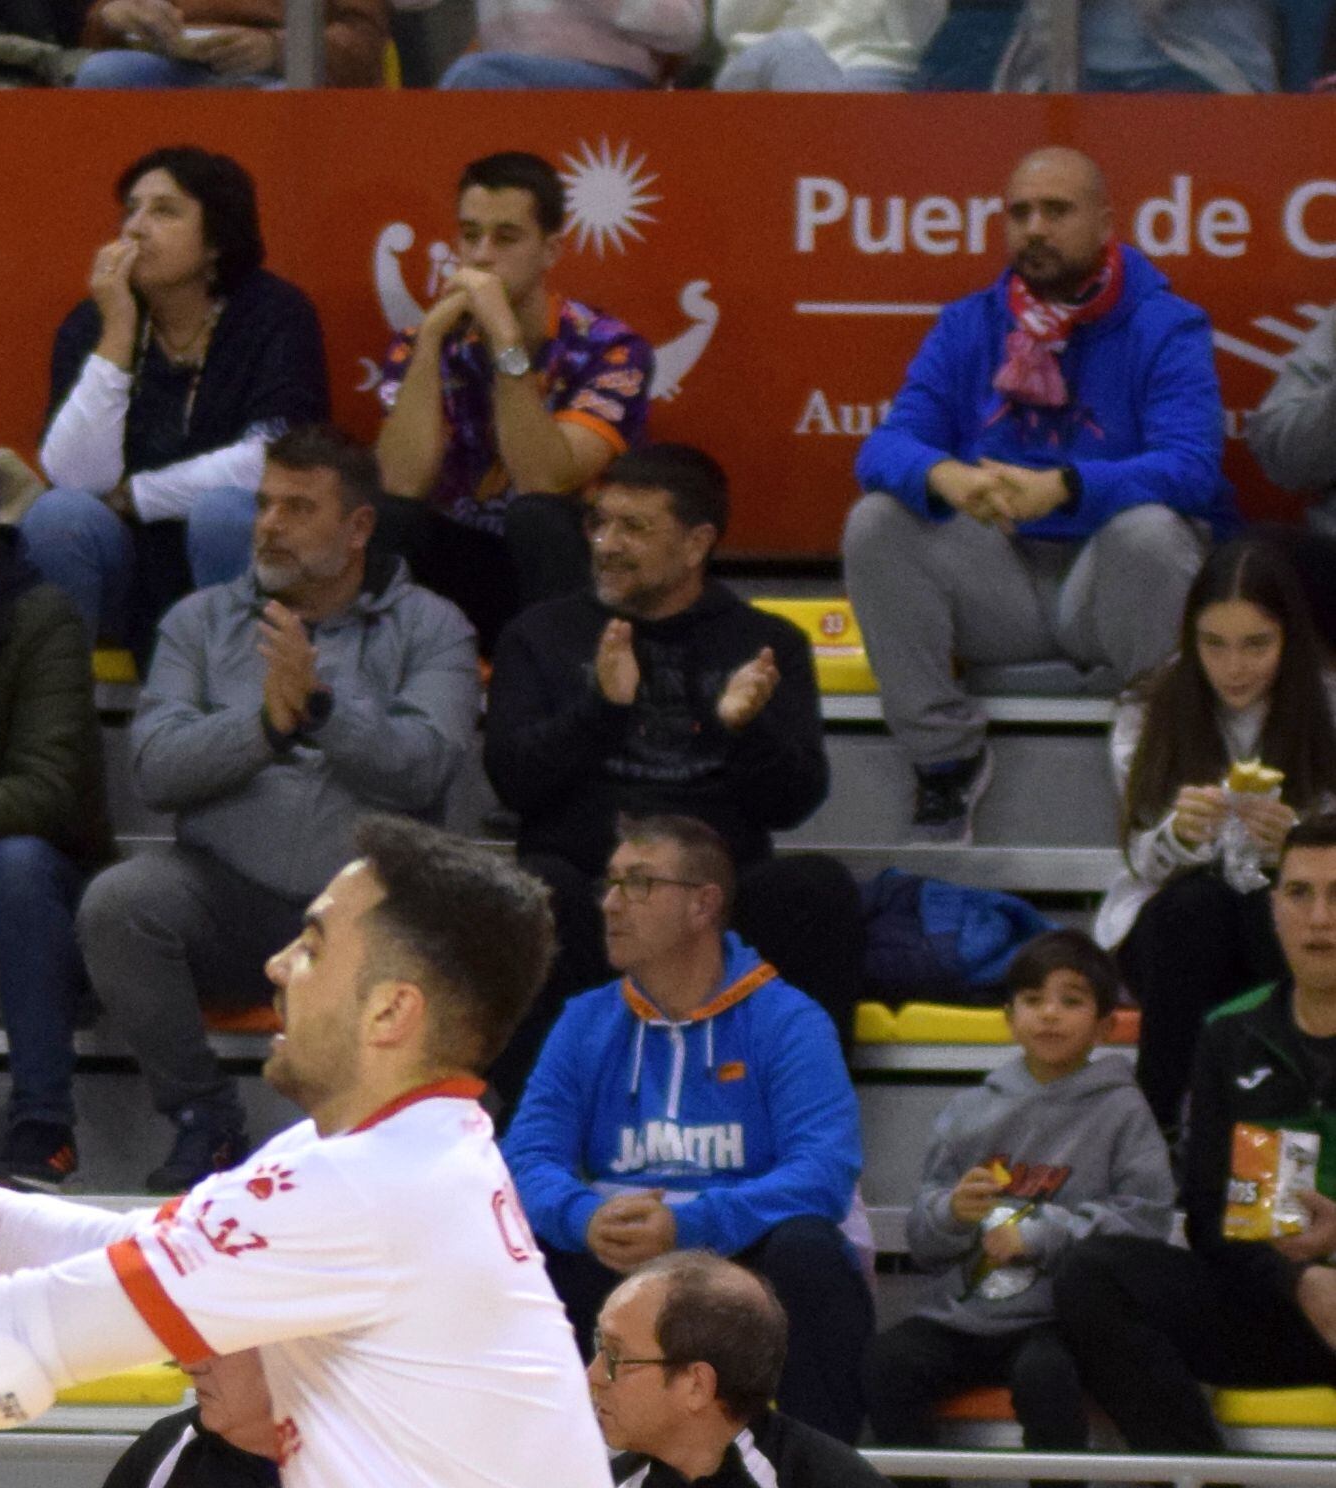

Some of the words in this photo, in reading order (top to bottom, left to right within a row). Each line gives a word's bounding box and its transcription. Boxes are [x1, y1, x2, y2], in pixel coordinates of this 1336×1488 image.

[794, 175, 1005, 255] Puer
[1133, 174, 1251, 257] de
[1280, 178, 1336, 259] C
[794, 389, 893, 438] Aut
